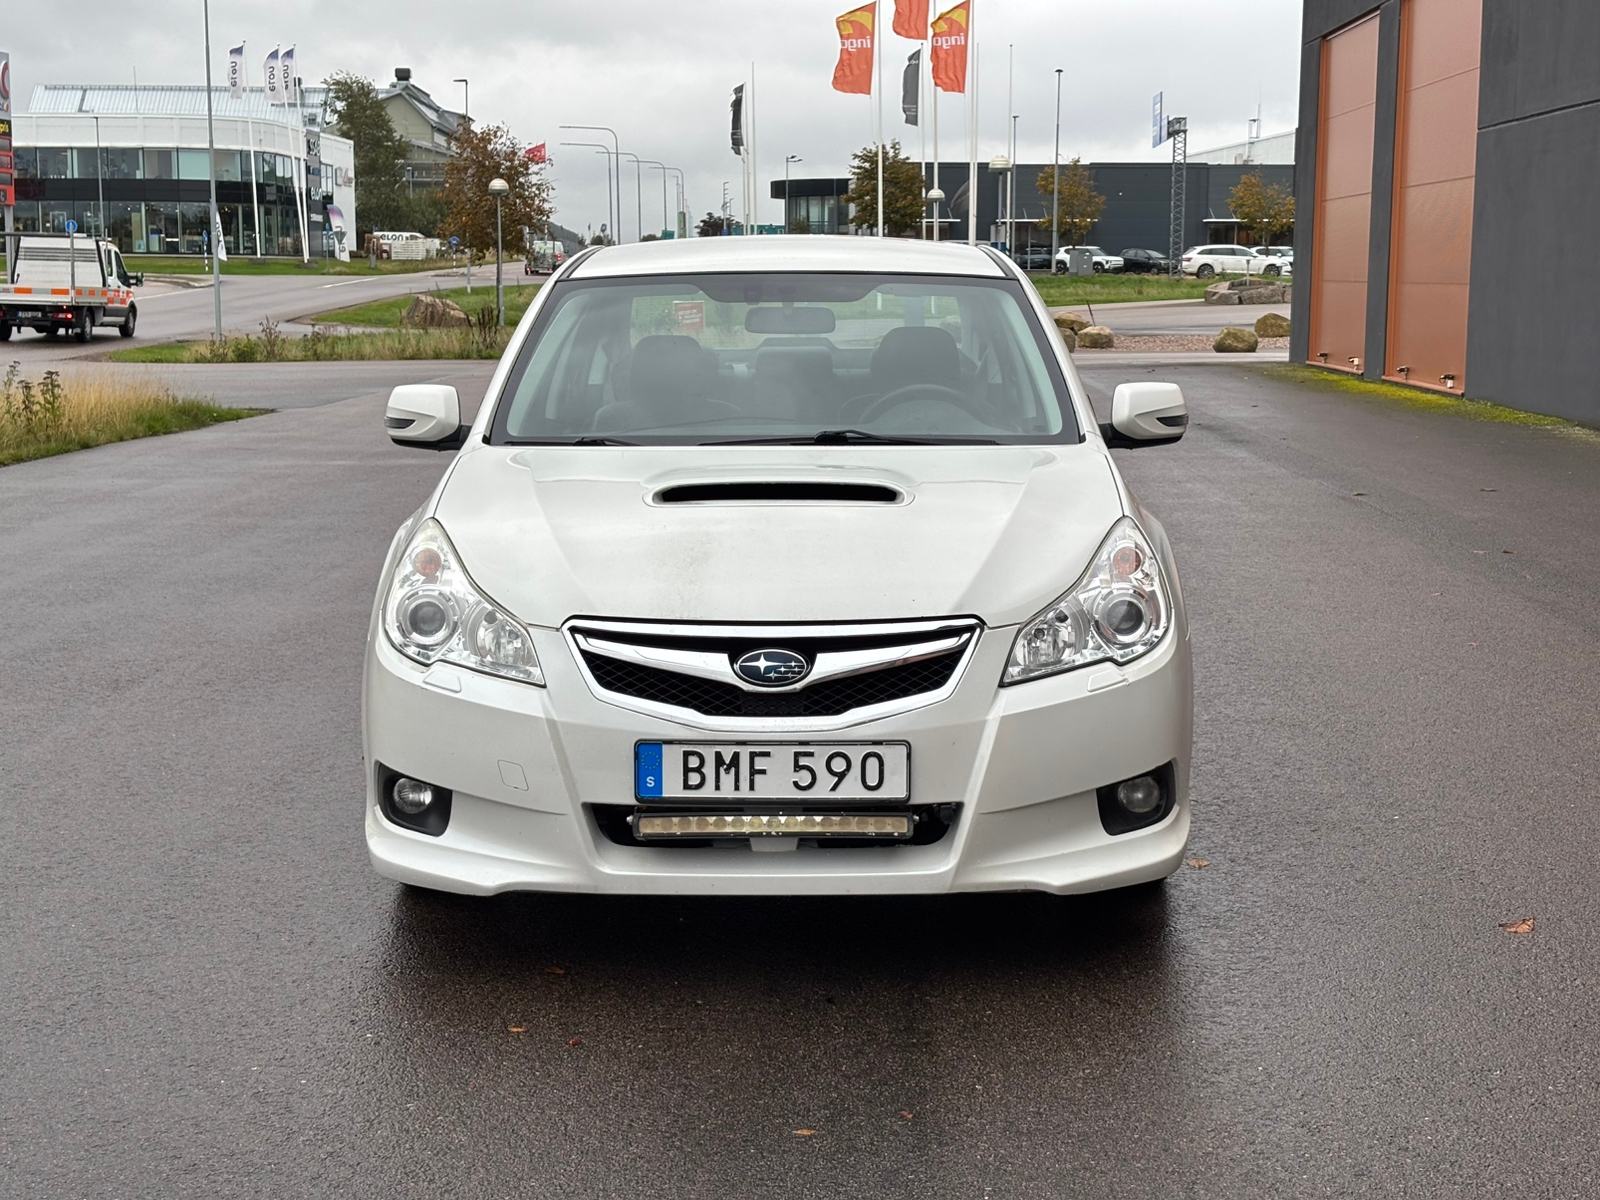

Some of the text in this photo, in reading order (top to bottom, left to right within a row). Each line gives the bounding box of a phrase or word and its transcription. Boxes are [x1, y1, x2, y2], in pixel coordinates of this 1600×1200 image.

[646, 776, 655, 788] S
[682, 750, 885, 791] BMF 590
